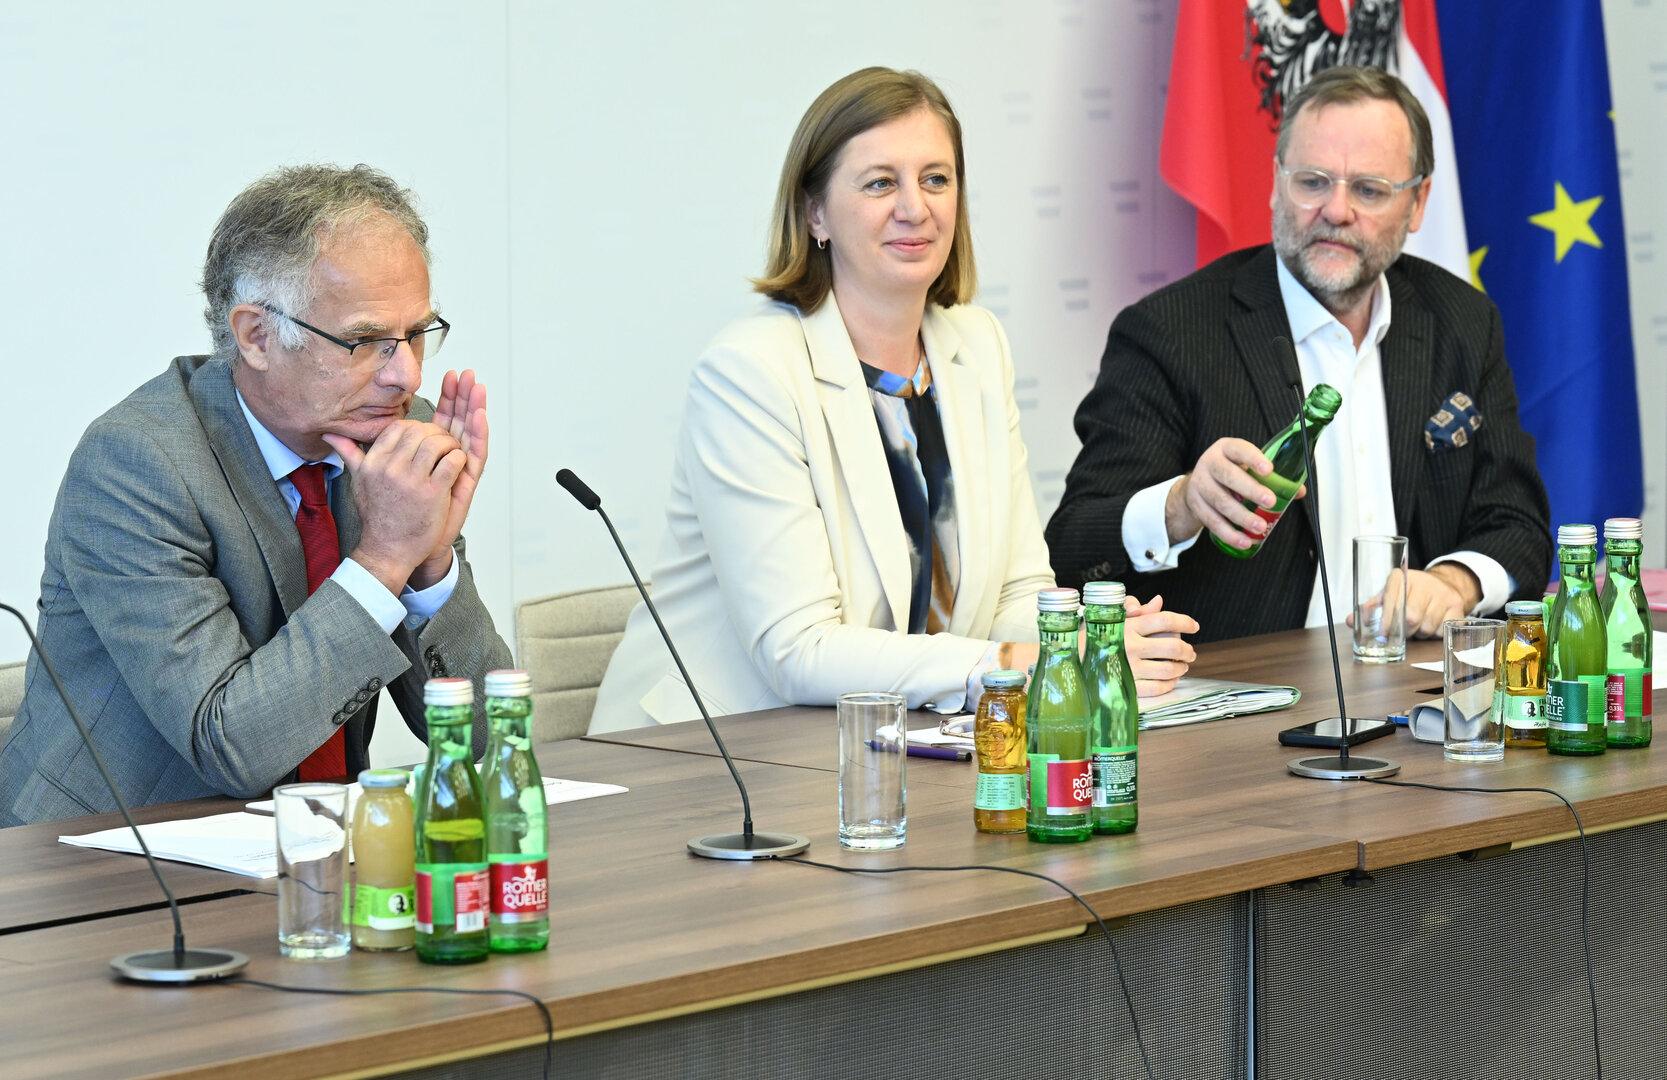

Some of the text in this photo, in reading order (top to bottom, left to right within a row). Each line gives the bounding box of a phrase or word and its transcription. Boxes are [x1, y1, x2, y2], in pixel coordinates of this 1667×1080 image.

[1546, 694, 1564, 707] MER
[1547, 704, 1563, 717] ELLE
[1073, 787, 1093, 802] QUE
[502, 890, 548, 910] QUELLE
